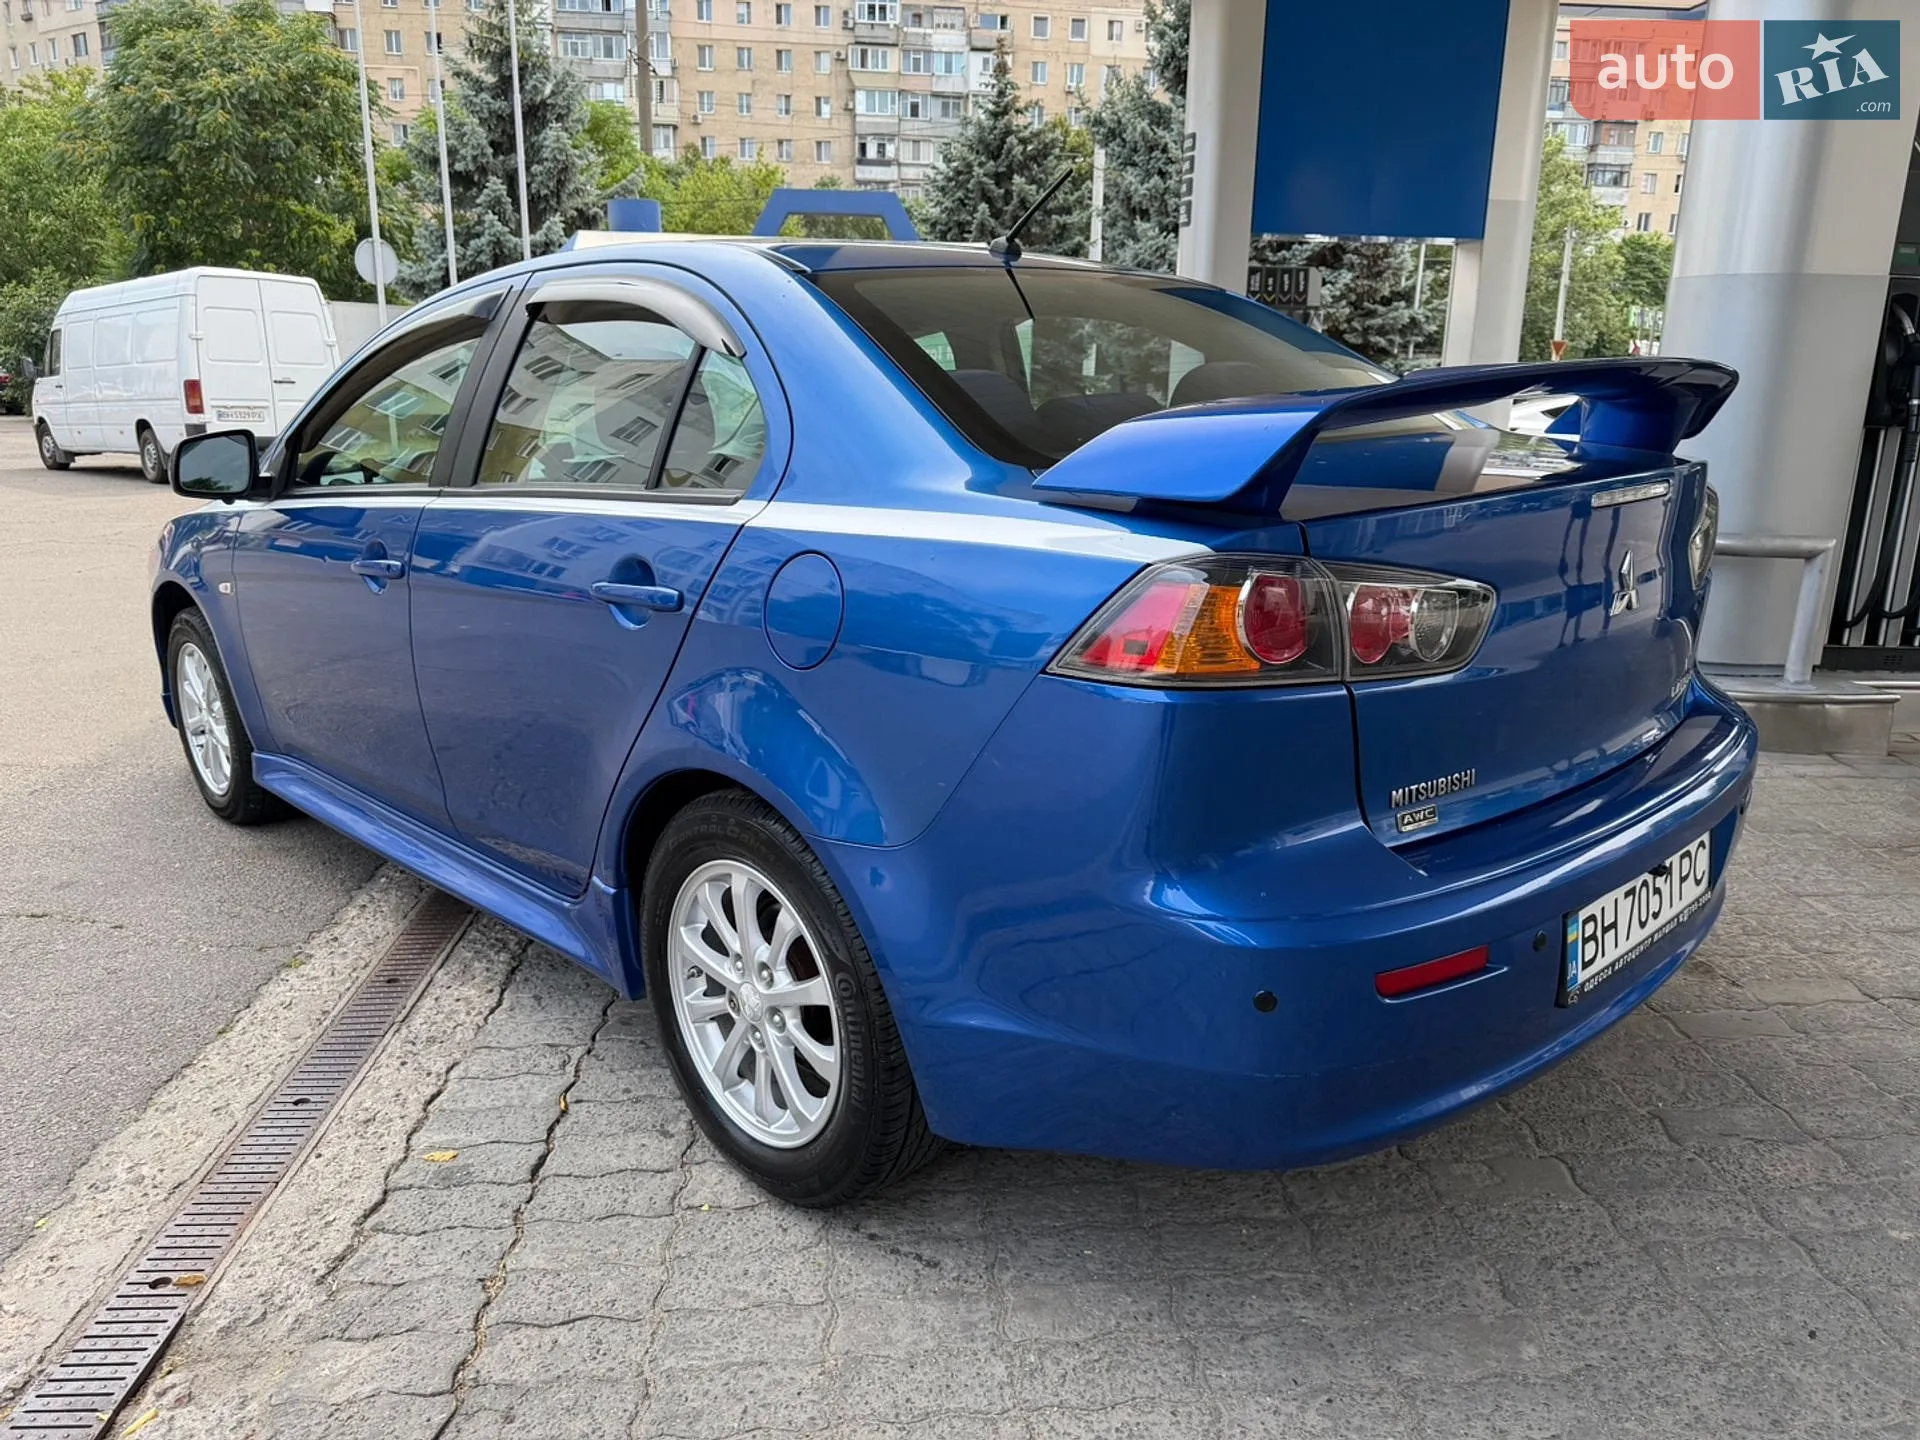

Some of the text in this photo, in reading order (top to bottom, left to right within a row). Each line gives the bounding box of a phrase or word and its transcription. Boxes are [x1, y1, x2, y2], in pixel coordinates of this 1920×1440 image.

[1391, 768, 1476, 809] MITSUBISHI
[1403, 808, 1435, 825] AWC
[1581, 897, 1618, 971] BH
[1624, 860, 1673, 942] 7051
[1679, 839, 1706, 901] PC
